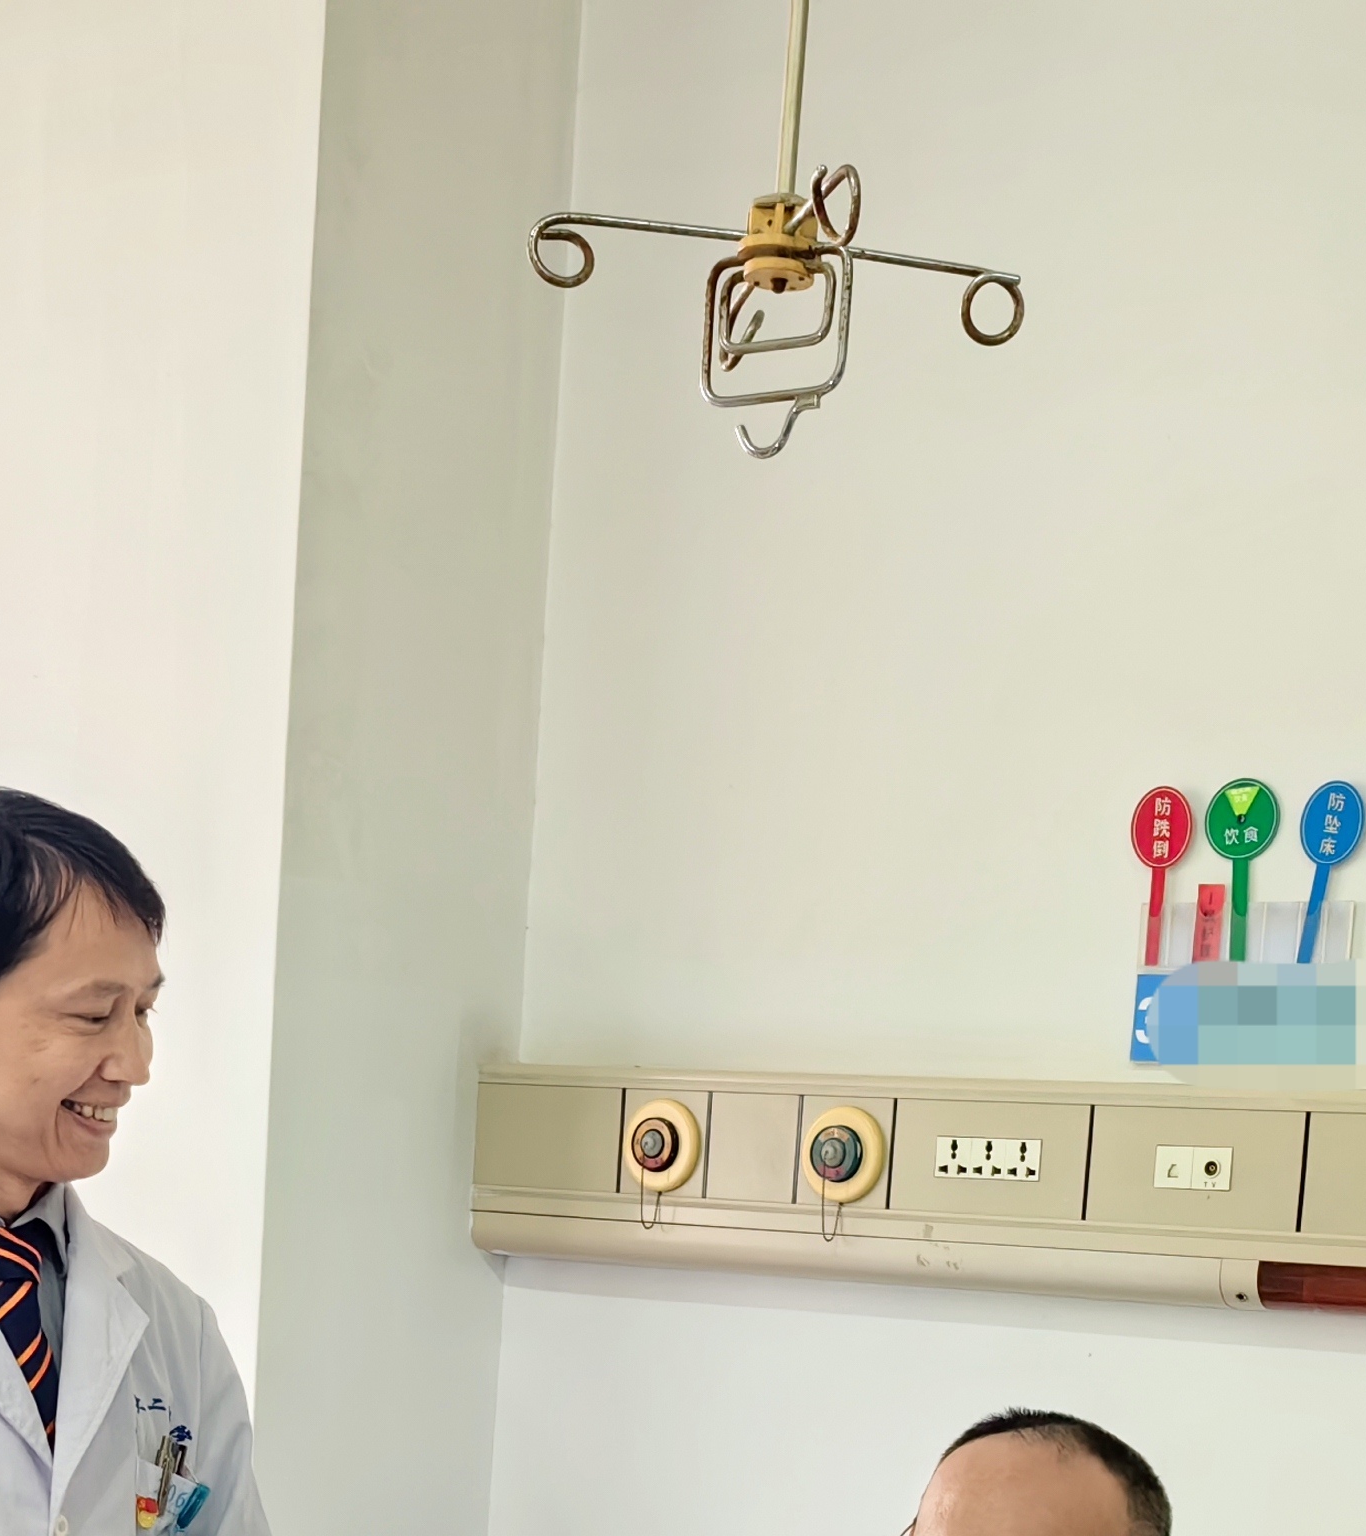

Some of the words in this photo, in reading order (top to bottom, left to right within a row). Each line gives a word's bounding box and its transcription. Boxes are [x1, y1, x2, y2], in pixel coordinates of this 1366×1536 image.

[1152, 797, 1172, 859] 防跌倒
[1224, 826, 1259, 846] 饮食
[1319, 792, 1346, 857] 防坠床
